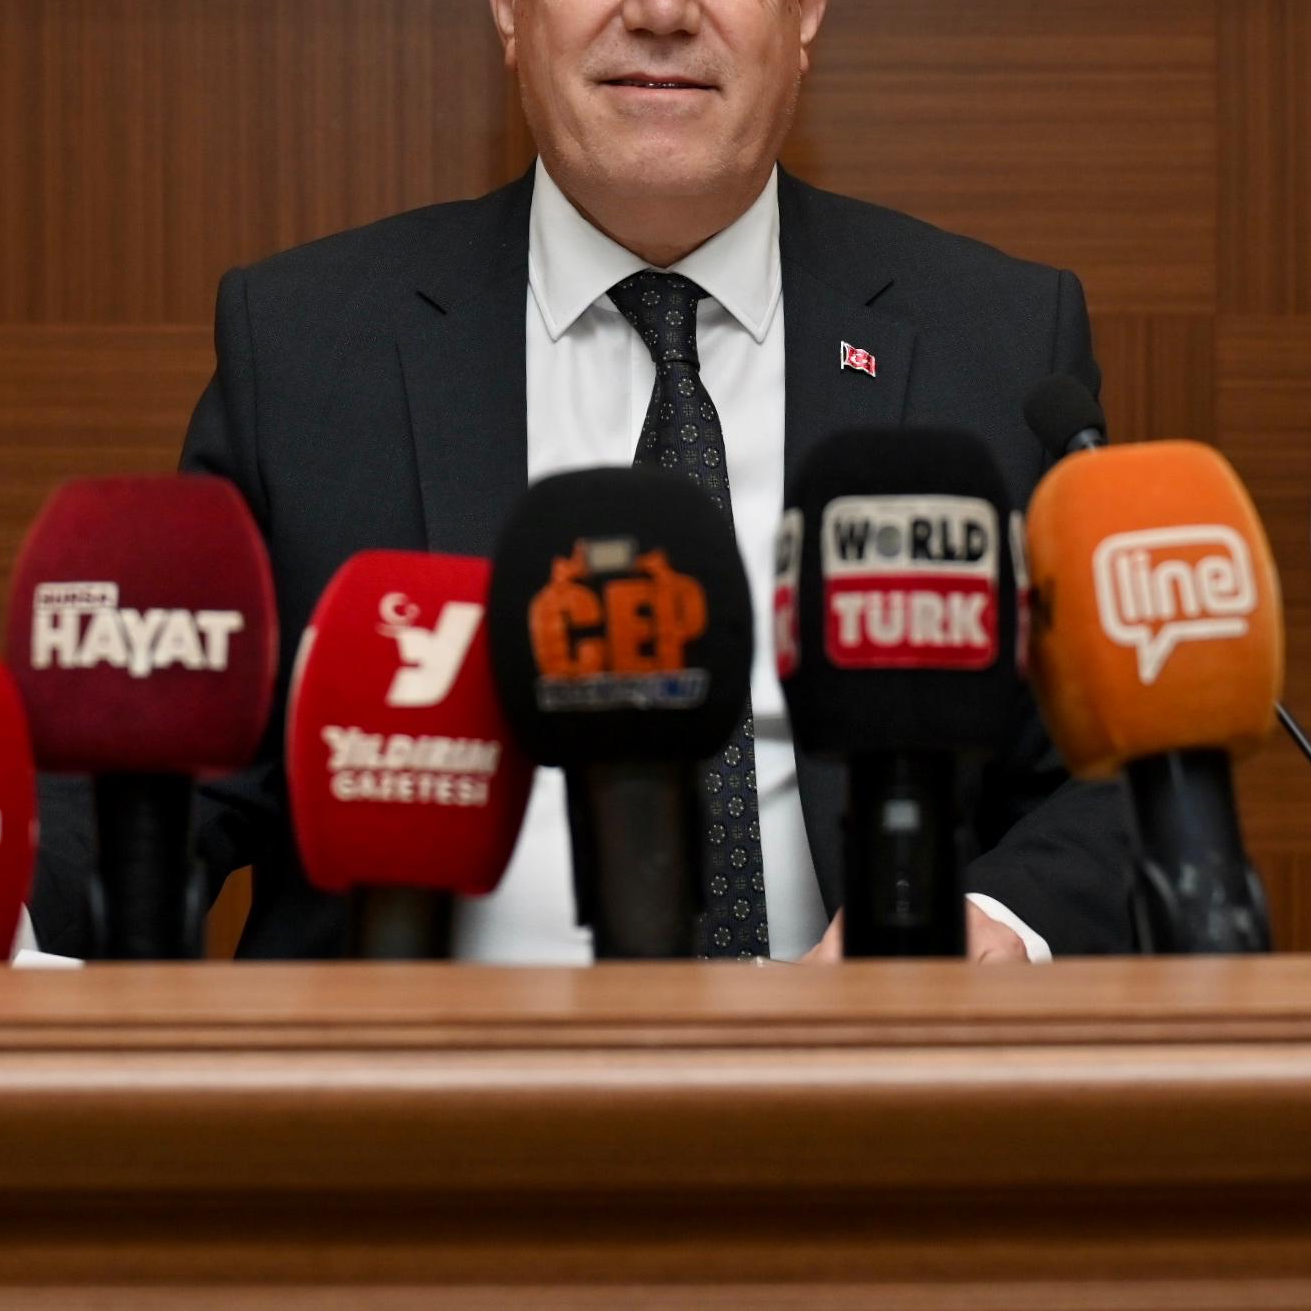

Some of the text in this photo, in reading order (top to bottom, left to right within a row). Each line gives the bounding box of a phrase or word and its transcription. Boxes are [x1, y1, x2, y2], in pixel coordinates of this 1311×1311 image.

[834, 518, 988, 563] WORLD
[1115, 549, 1251, 623] line
[32, 608, 245, 678] HAYAT
[831, 591, 990, 648] TURK
